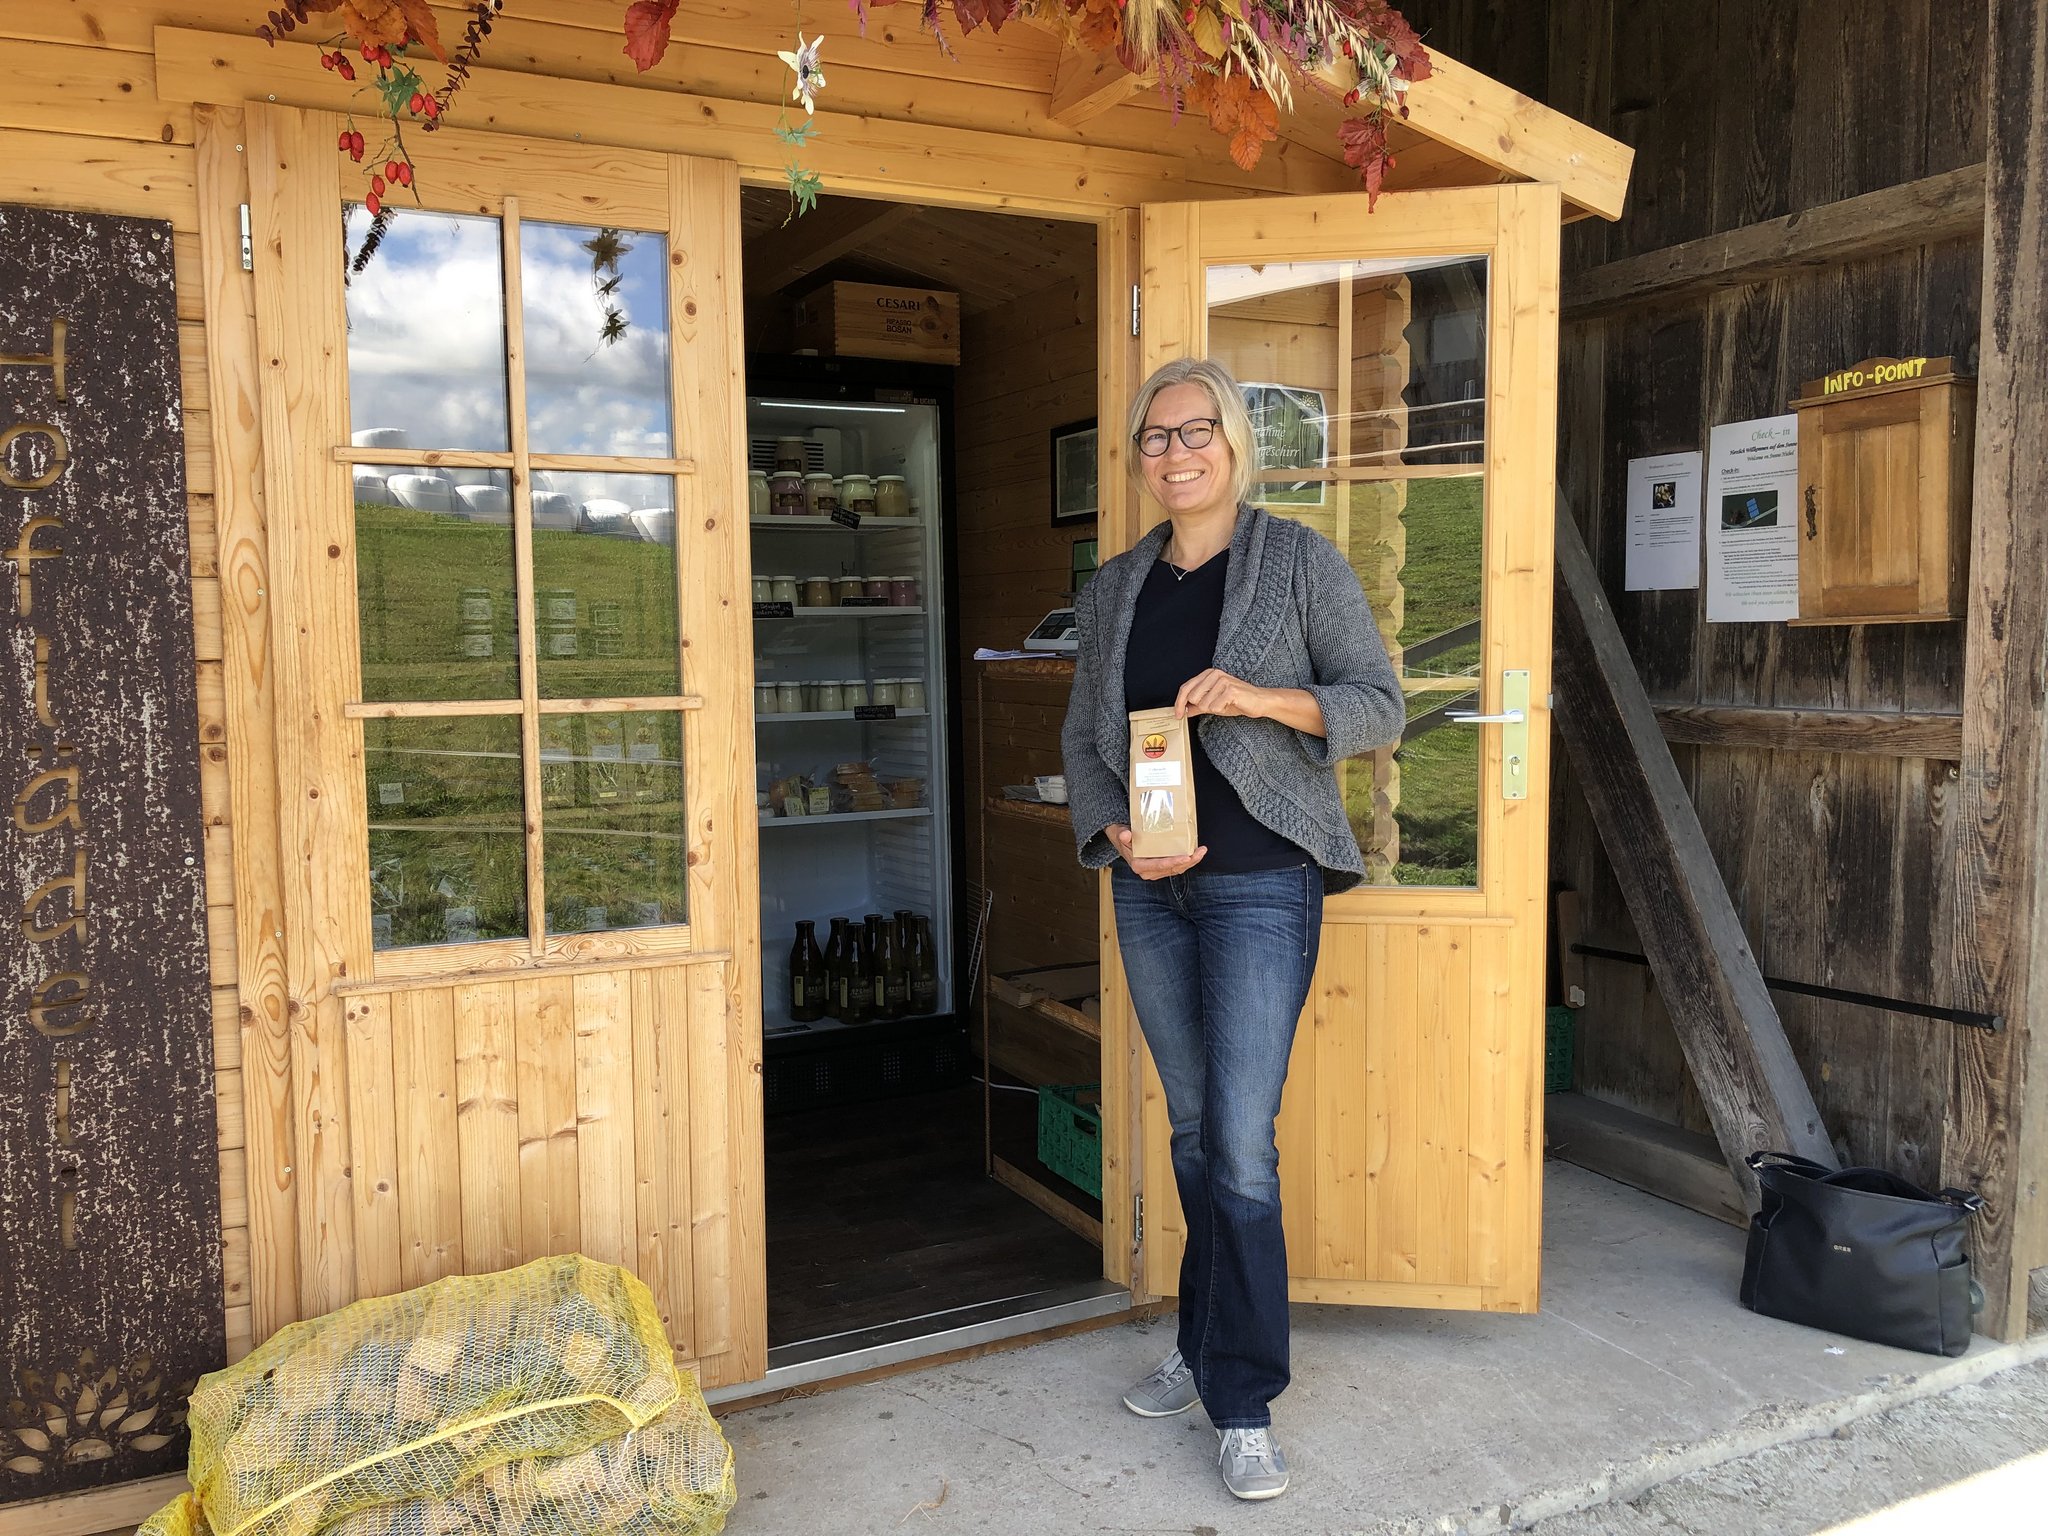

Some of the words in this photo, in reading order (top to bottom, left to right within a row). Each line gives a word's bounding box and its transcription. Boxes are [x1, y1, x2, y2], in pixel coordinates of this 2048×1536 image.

[876, 297, 920, 311] CESARI
[886, 325, 912, 334] BOSAN
[1824, 357, 1927, 395] INFO-POINT
[1751, 428, 1774, 441] Check
[1782, 426, 1791, 436] in
